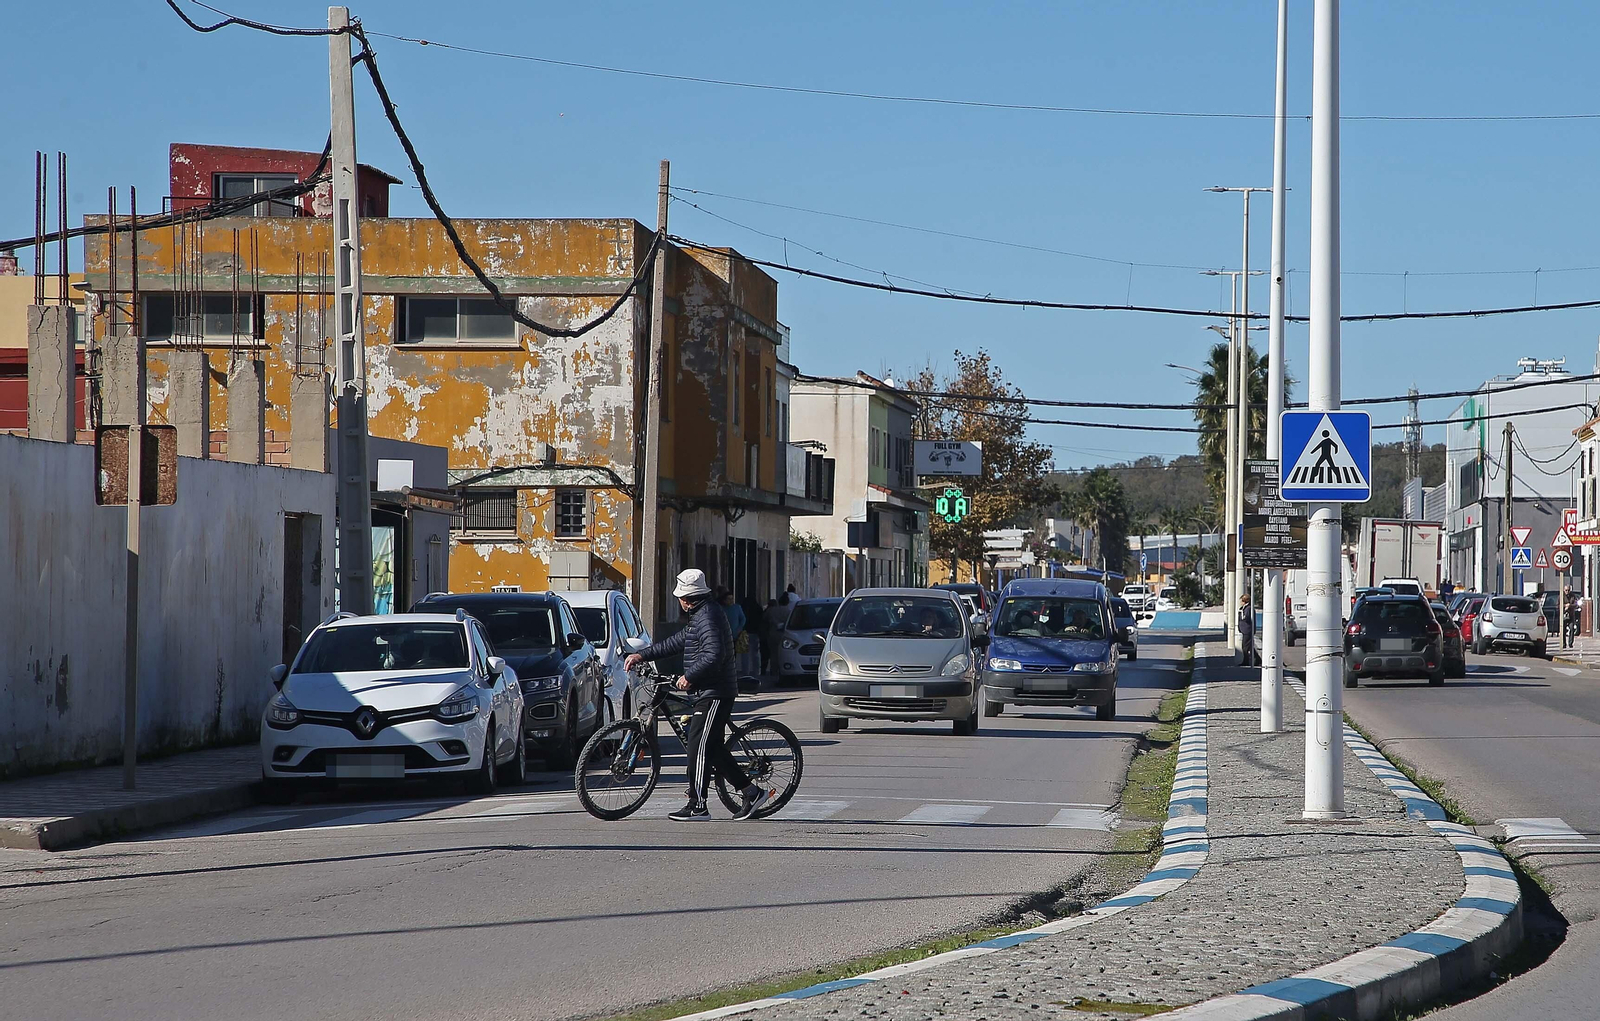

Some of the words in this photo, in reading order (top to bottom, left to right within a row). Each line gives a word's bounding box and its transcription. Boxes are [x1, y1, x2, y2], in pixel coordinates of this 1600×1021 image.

[934, 442, 947, 450] FULL
[948, 442, 961, 450] GYM
[1555, 555, 1569, 564] 30
